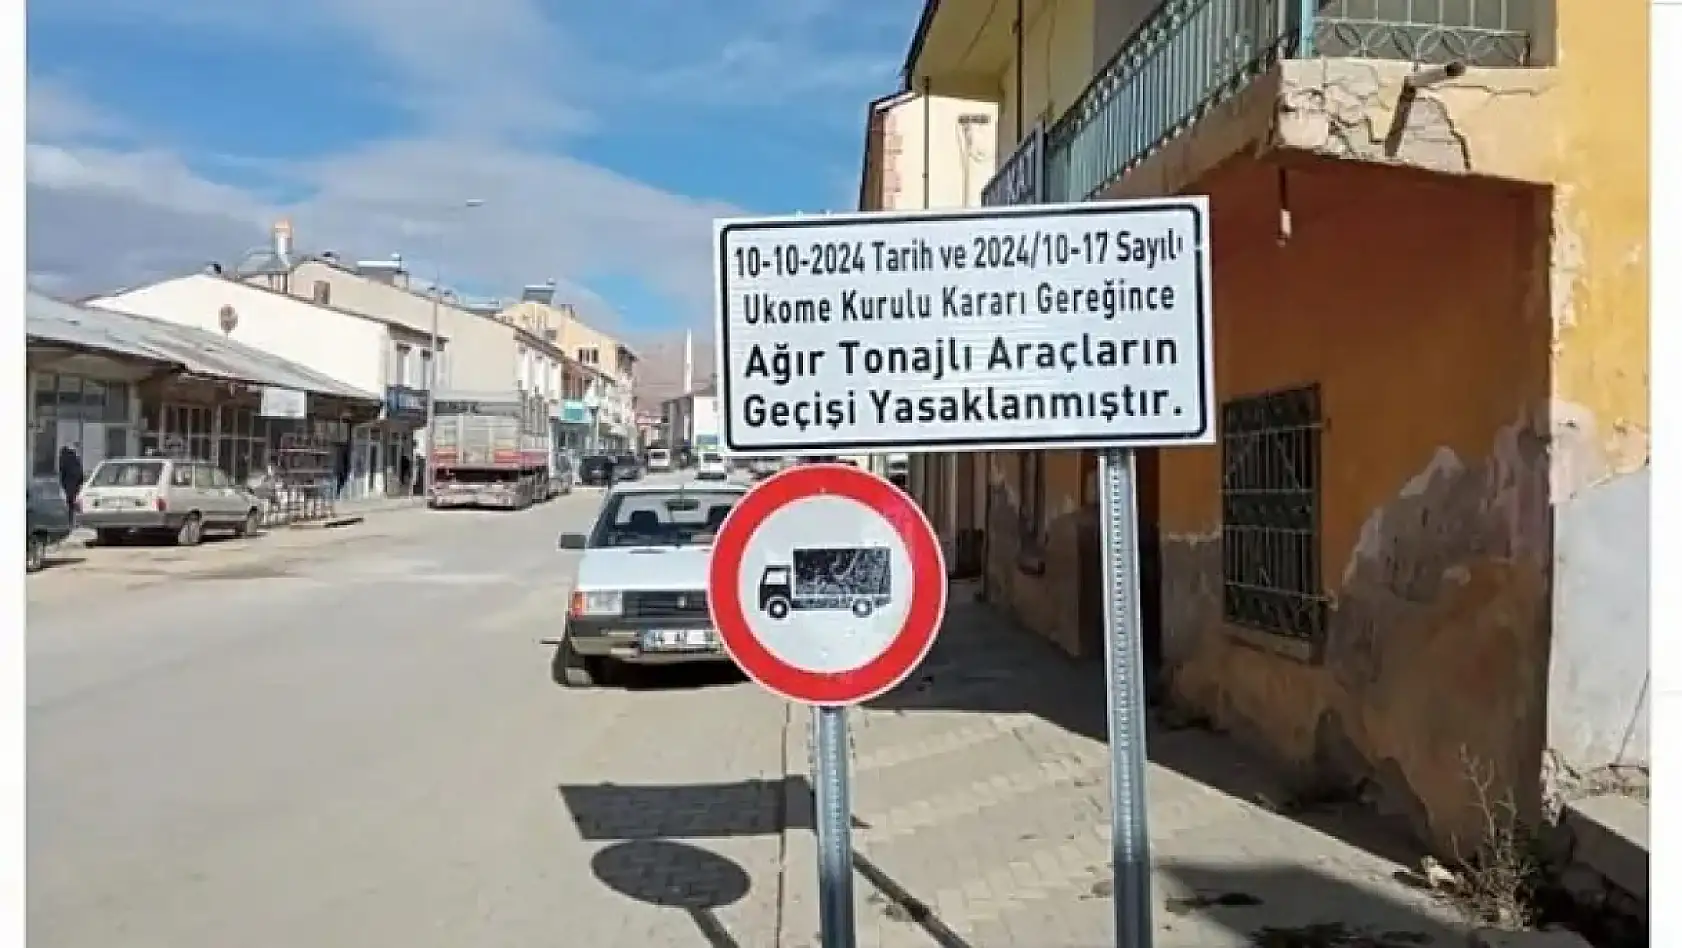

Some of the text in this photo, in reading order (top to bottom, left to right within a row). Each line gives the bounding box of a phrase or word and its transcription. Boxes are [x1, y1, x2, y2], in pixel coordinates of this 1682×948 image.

[734, 228, 1183, 277] 10-10-2024 Tarih ve 2024/10-17 Sayılı
[744, 278, 1174, 324] Ukome Kurulu Kararı Gereğince
[745, 333, 1177, 385] Ağır Tonajlı Araçların
[744, 384, 1182, 432] Geçişi Yasaklanmıştır.
